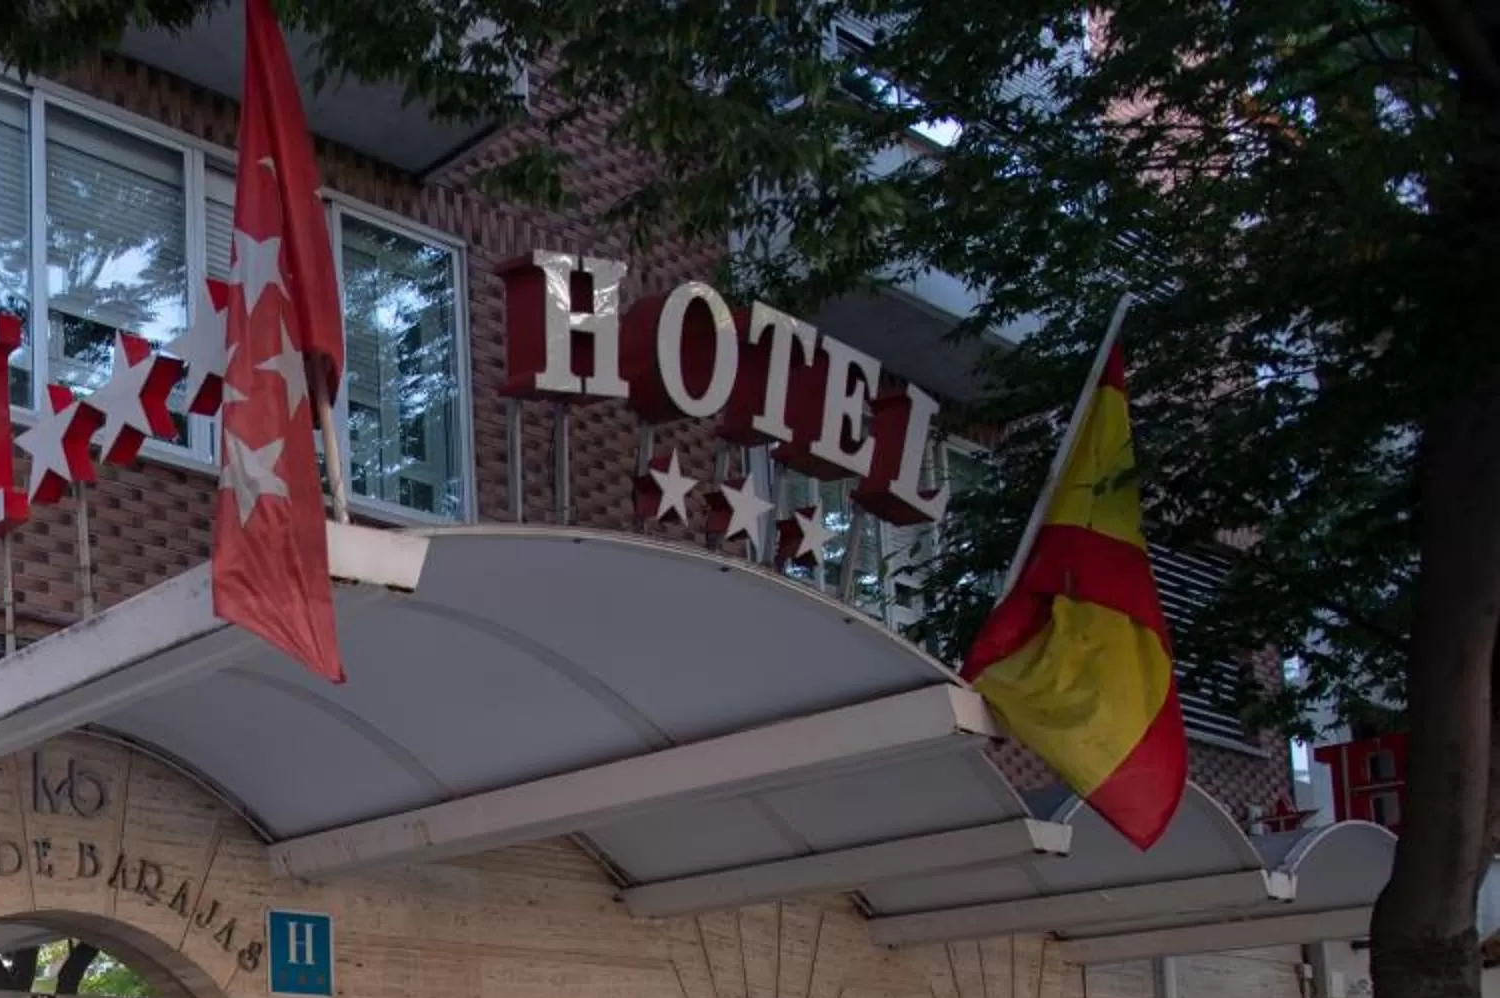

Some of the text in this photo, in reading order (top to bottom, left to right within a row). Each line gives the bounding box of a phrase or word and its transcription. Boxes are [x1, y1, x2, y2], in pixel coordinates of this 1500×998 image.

[531, 247, 951, 524] HOTEL
[76, 841, 263, 971] BARAJAS
[286, 920, 316, 965] H
